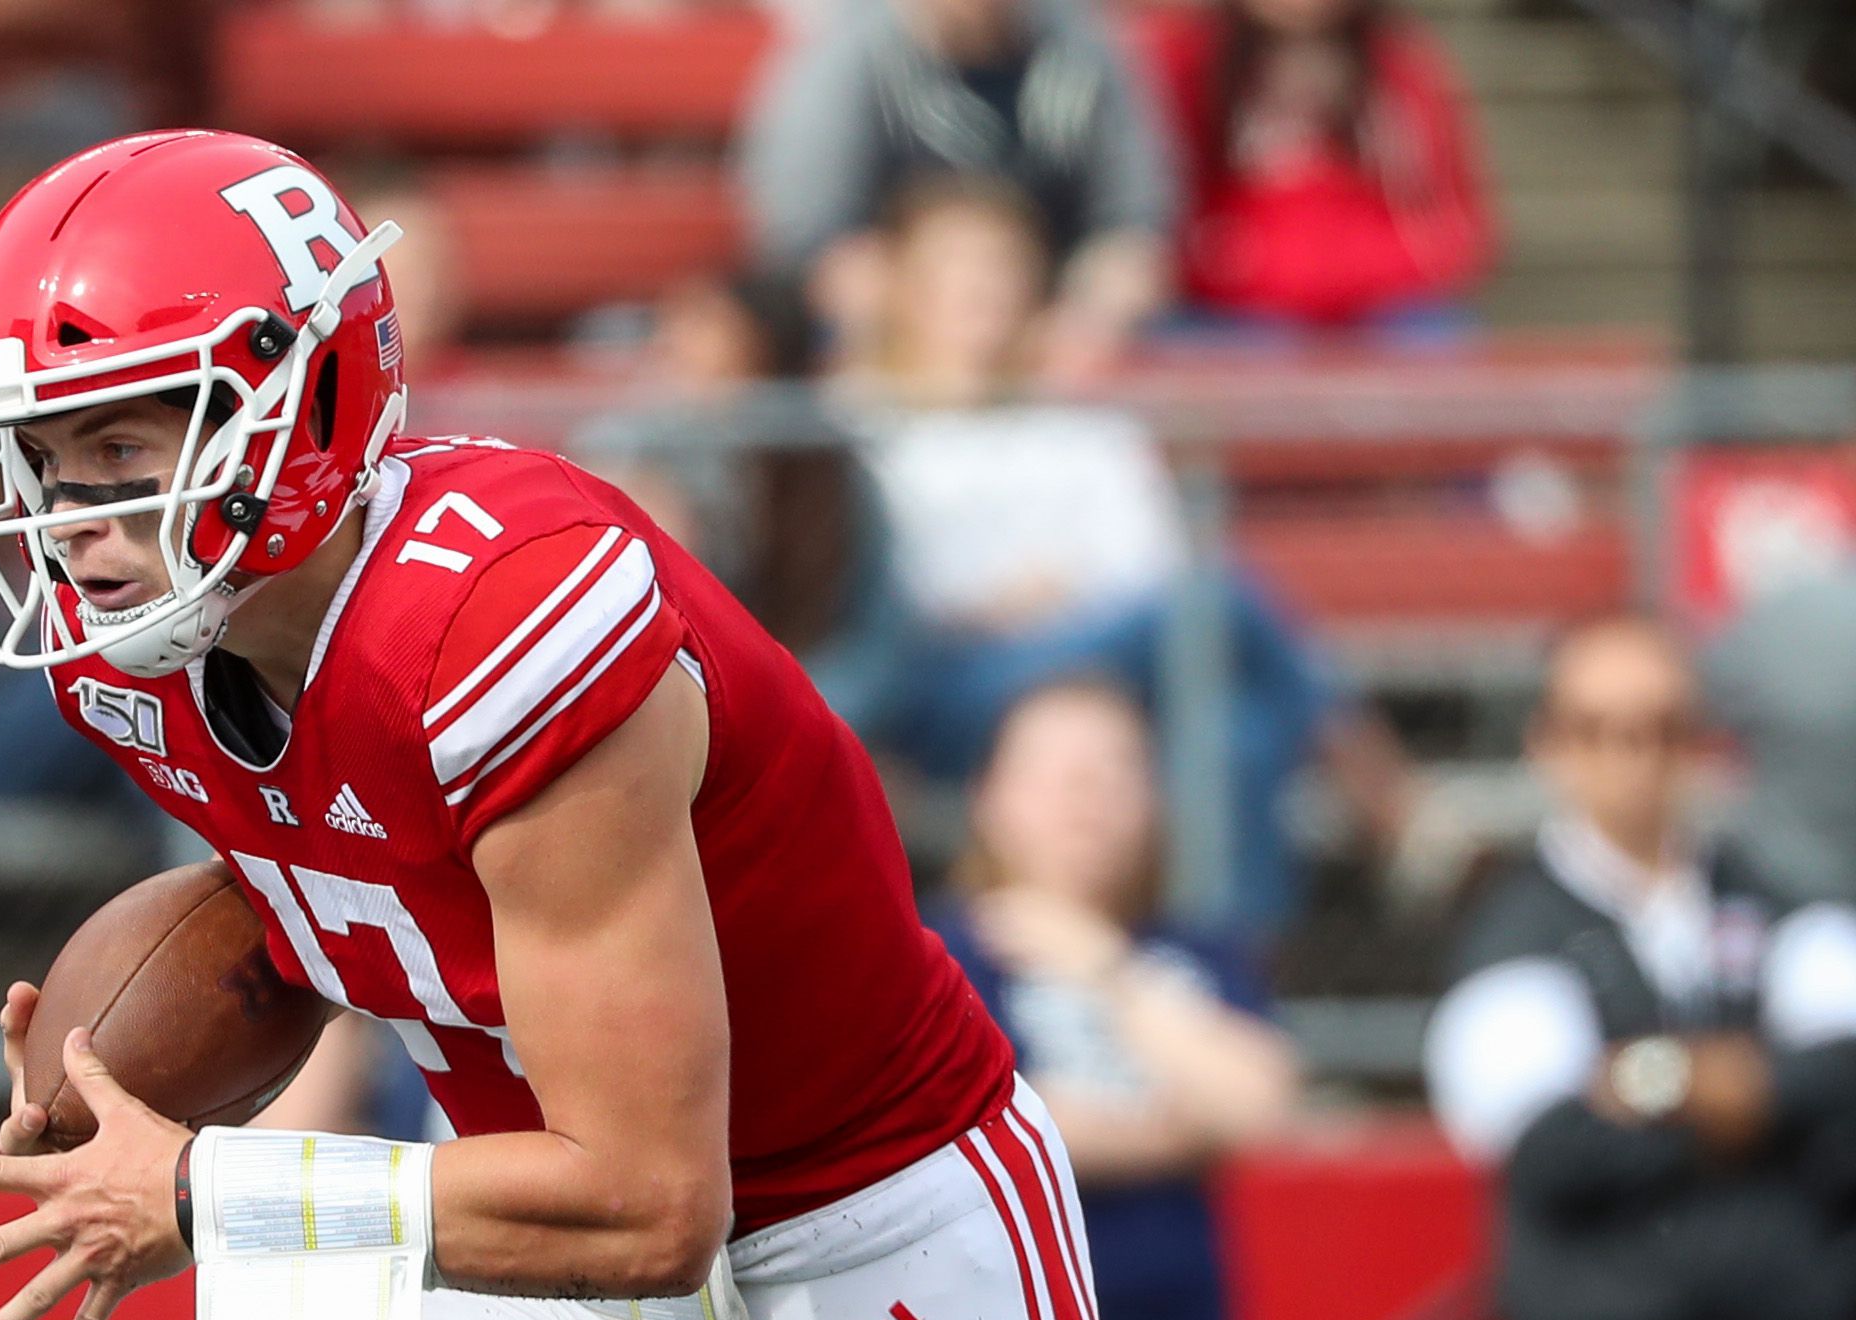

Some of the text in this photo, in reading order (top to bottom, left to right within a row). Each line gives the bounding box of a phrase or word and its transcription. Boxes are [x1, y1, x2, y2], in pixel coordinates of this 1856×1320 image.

[218, 165, 382, 313] R
[395, 490, 505, 574] 17
[67, 676, 167, 758] 150
[258, 784, 301, 828] R
[324, 811, 388, 840] adidas
[229, 849, 527, 1078] 17
